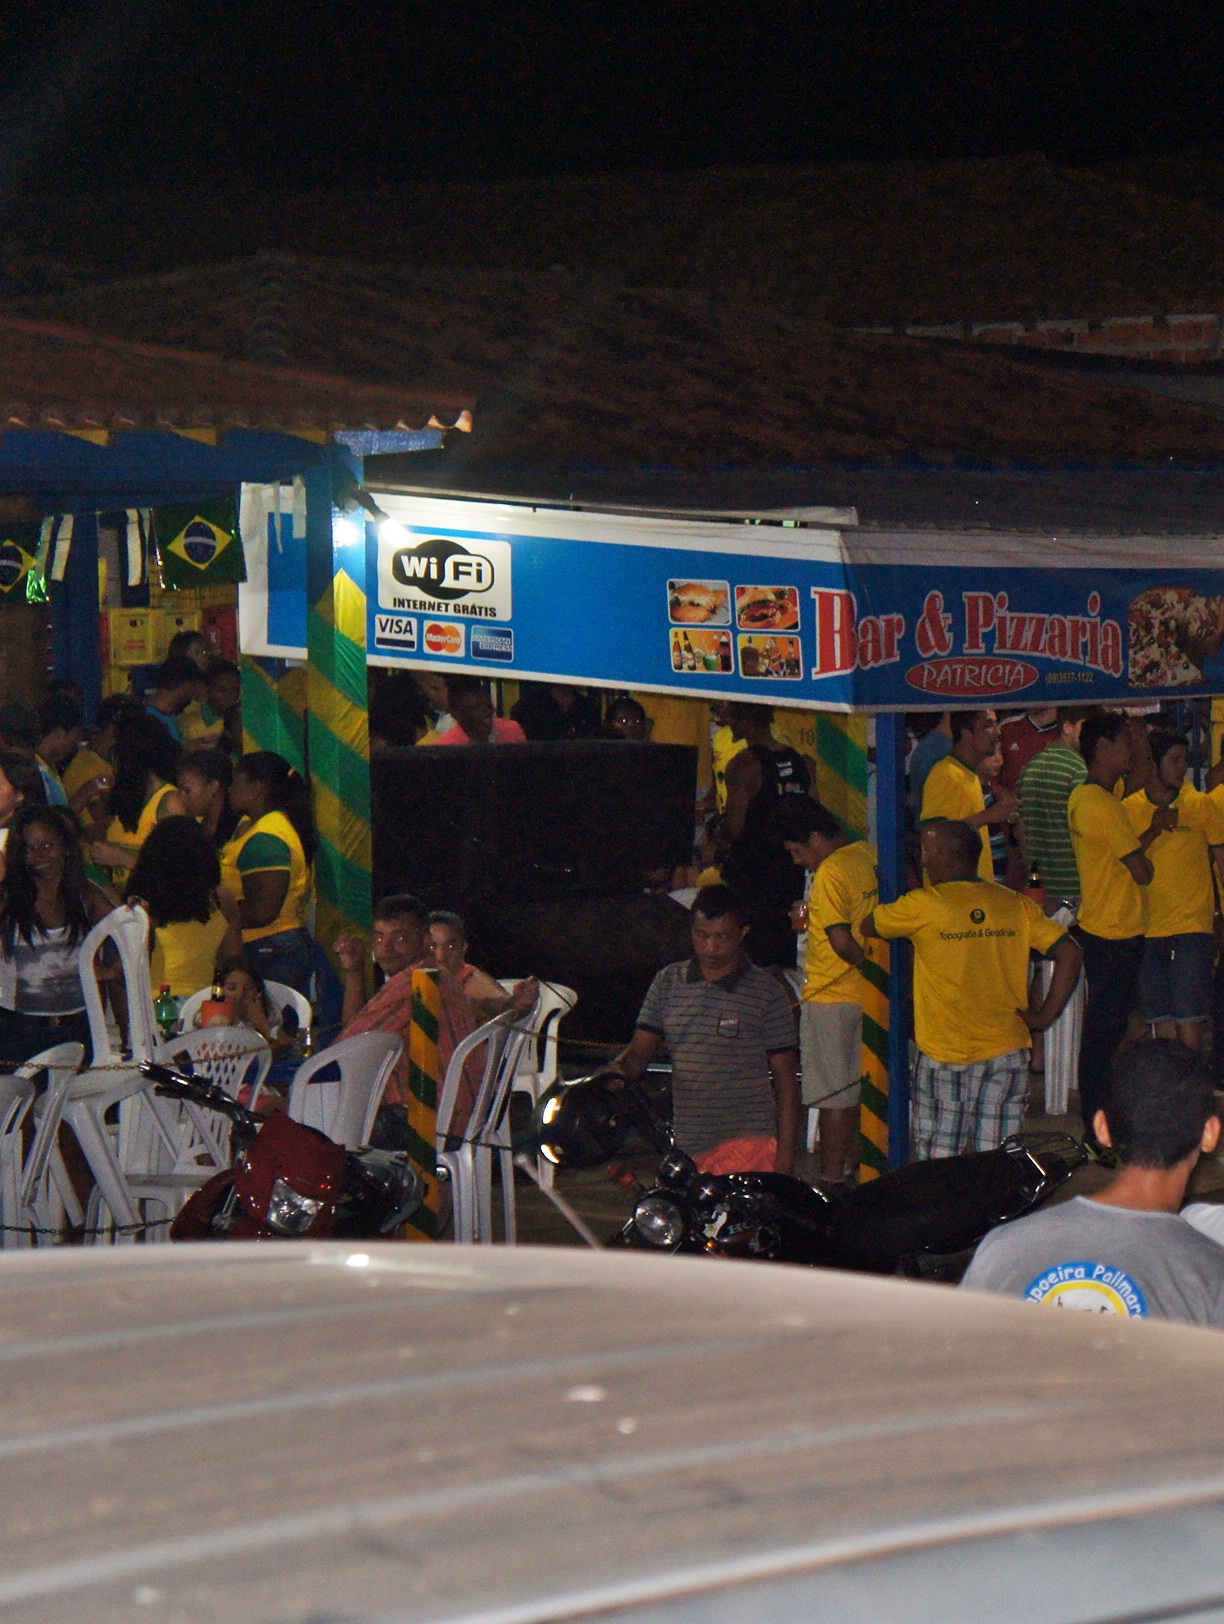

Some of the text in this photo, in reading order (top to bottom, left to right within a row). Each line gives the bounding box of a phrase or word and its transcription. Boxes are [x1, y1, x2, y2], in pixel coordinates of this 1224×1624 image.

[392, 597, 497, 617] INTERNET GRÁTIS
[378, 617, 413, 636] VISA
[811, 587, 1123, 680] Bar & Pizzaria
[426, 632, 461, 645] MasterCard
[922, 664, 1024, 688] PATRICIA
